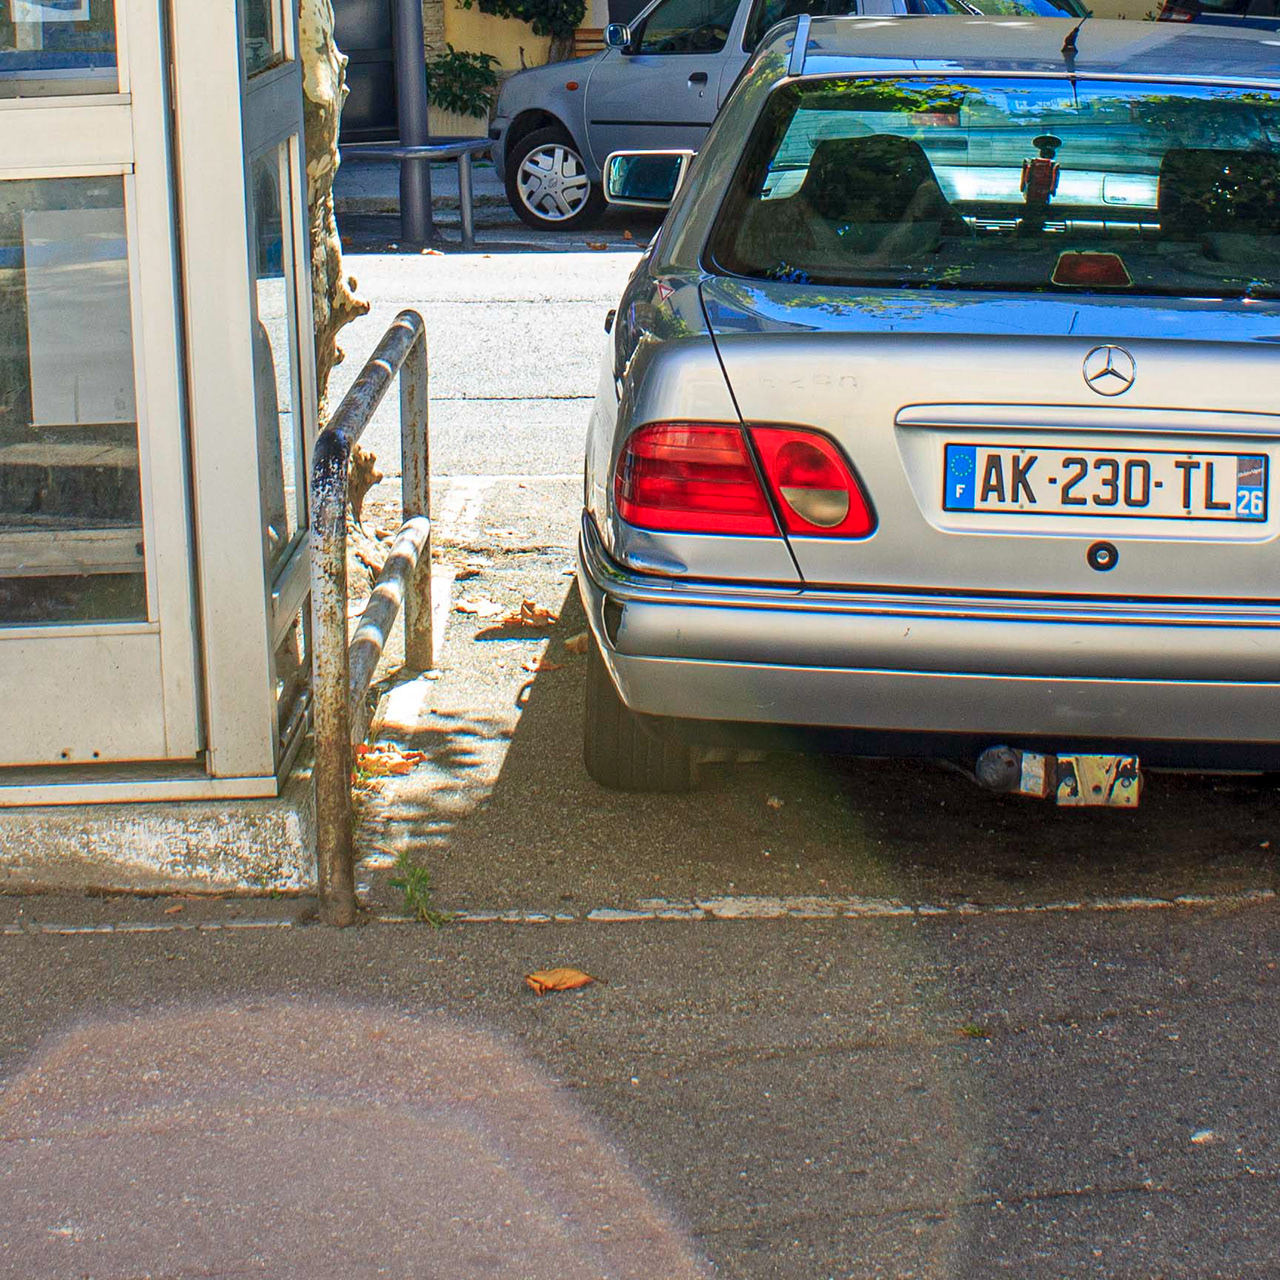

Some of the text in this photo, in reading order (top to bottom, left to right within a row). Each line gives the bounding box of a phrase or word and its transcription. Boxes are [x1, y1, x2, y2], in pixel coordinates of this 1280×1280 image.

[956, 484, 966, 498] F
[980, 453, 1232, 511] AK-230-TL
[1237, 490, 1264, 515] 26
